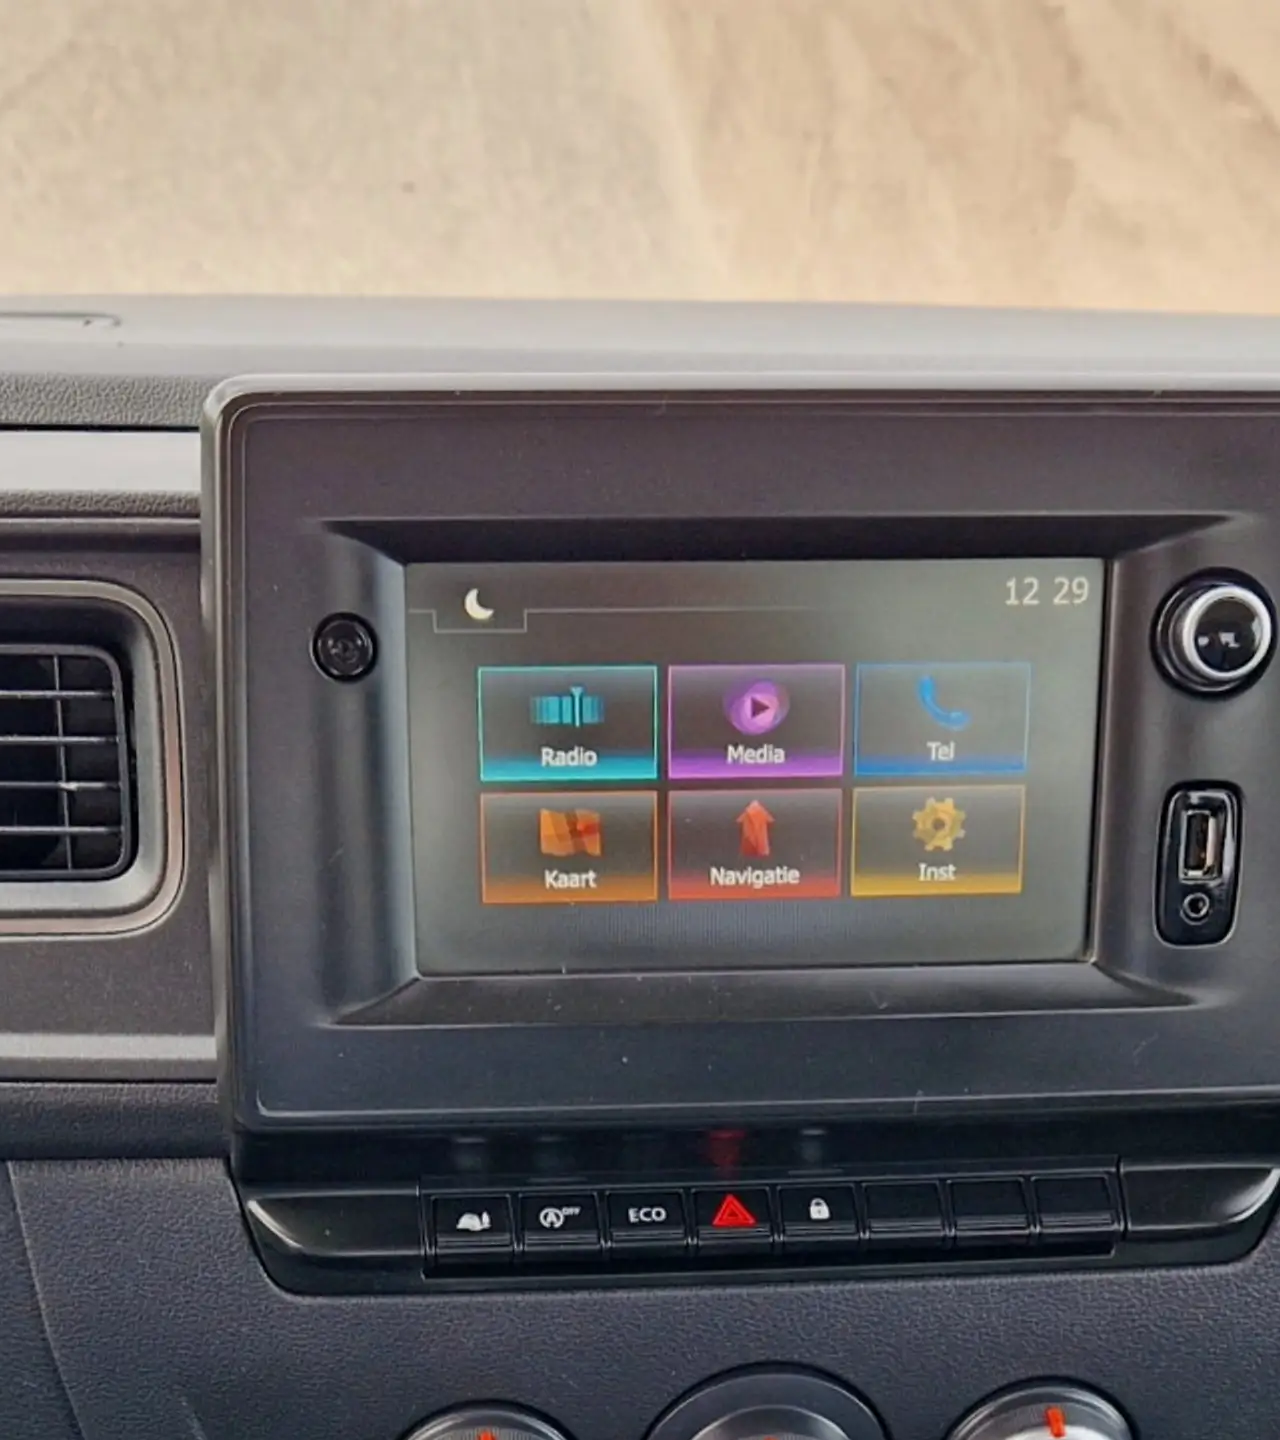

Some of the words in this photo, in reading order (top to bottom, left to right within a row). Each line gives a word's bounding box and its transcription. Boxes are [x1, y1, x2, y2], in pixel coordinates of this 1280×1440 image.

[1004, 576, 1040, 606] 12
[1052, 576, 1090, 605] 29
[539, 744, 599, 769] Radio
[725, 742, 787, 767] Media
[926, 740, 957, 763] Tel
[543, 867, 598, 890] Kaart
[708, 864, 801, 889] Navigatie
[917, 861, 957, 882] Inst
[627, 1207, 667, 1224] ECO
